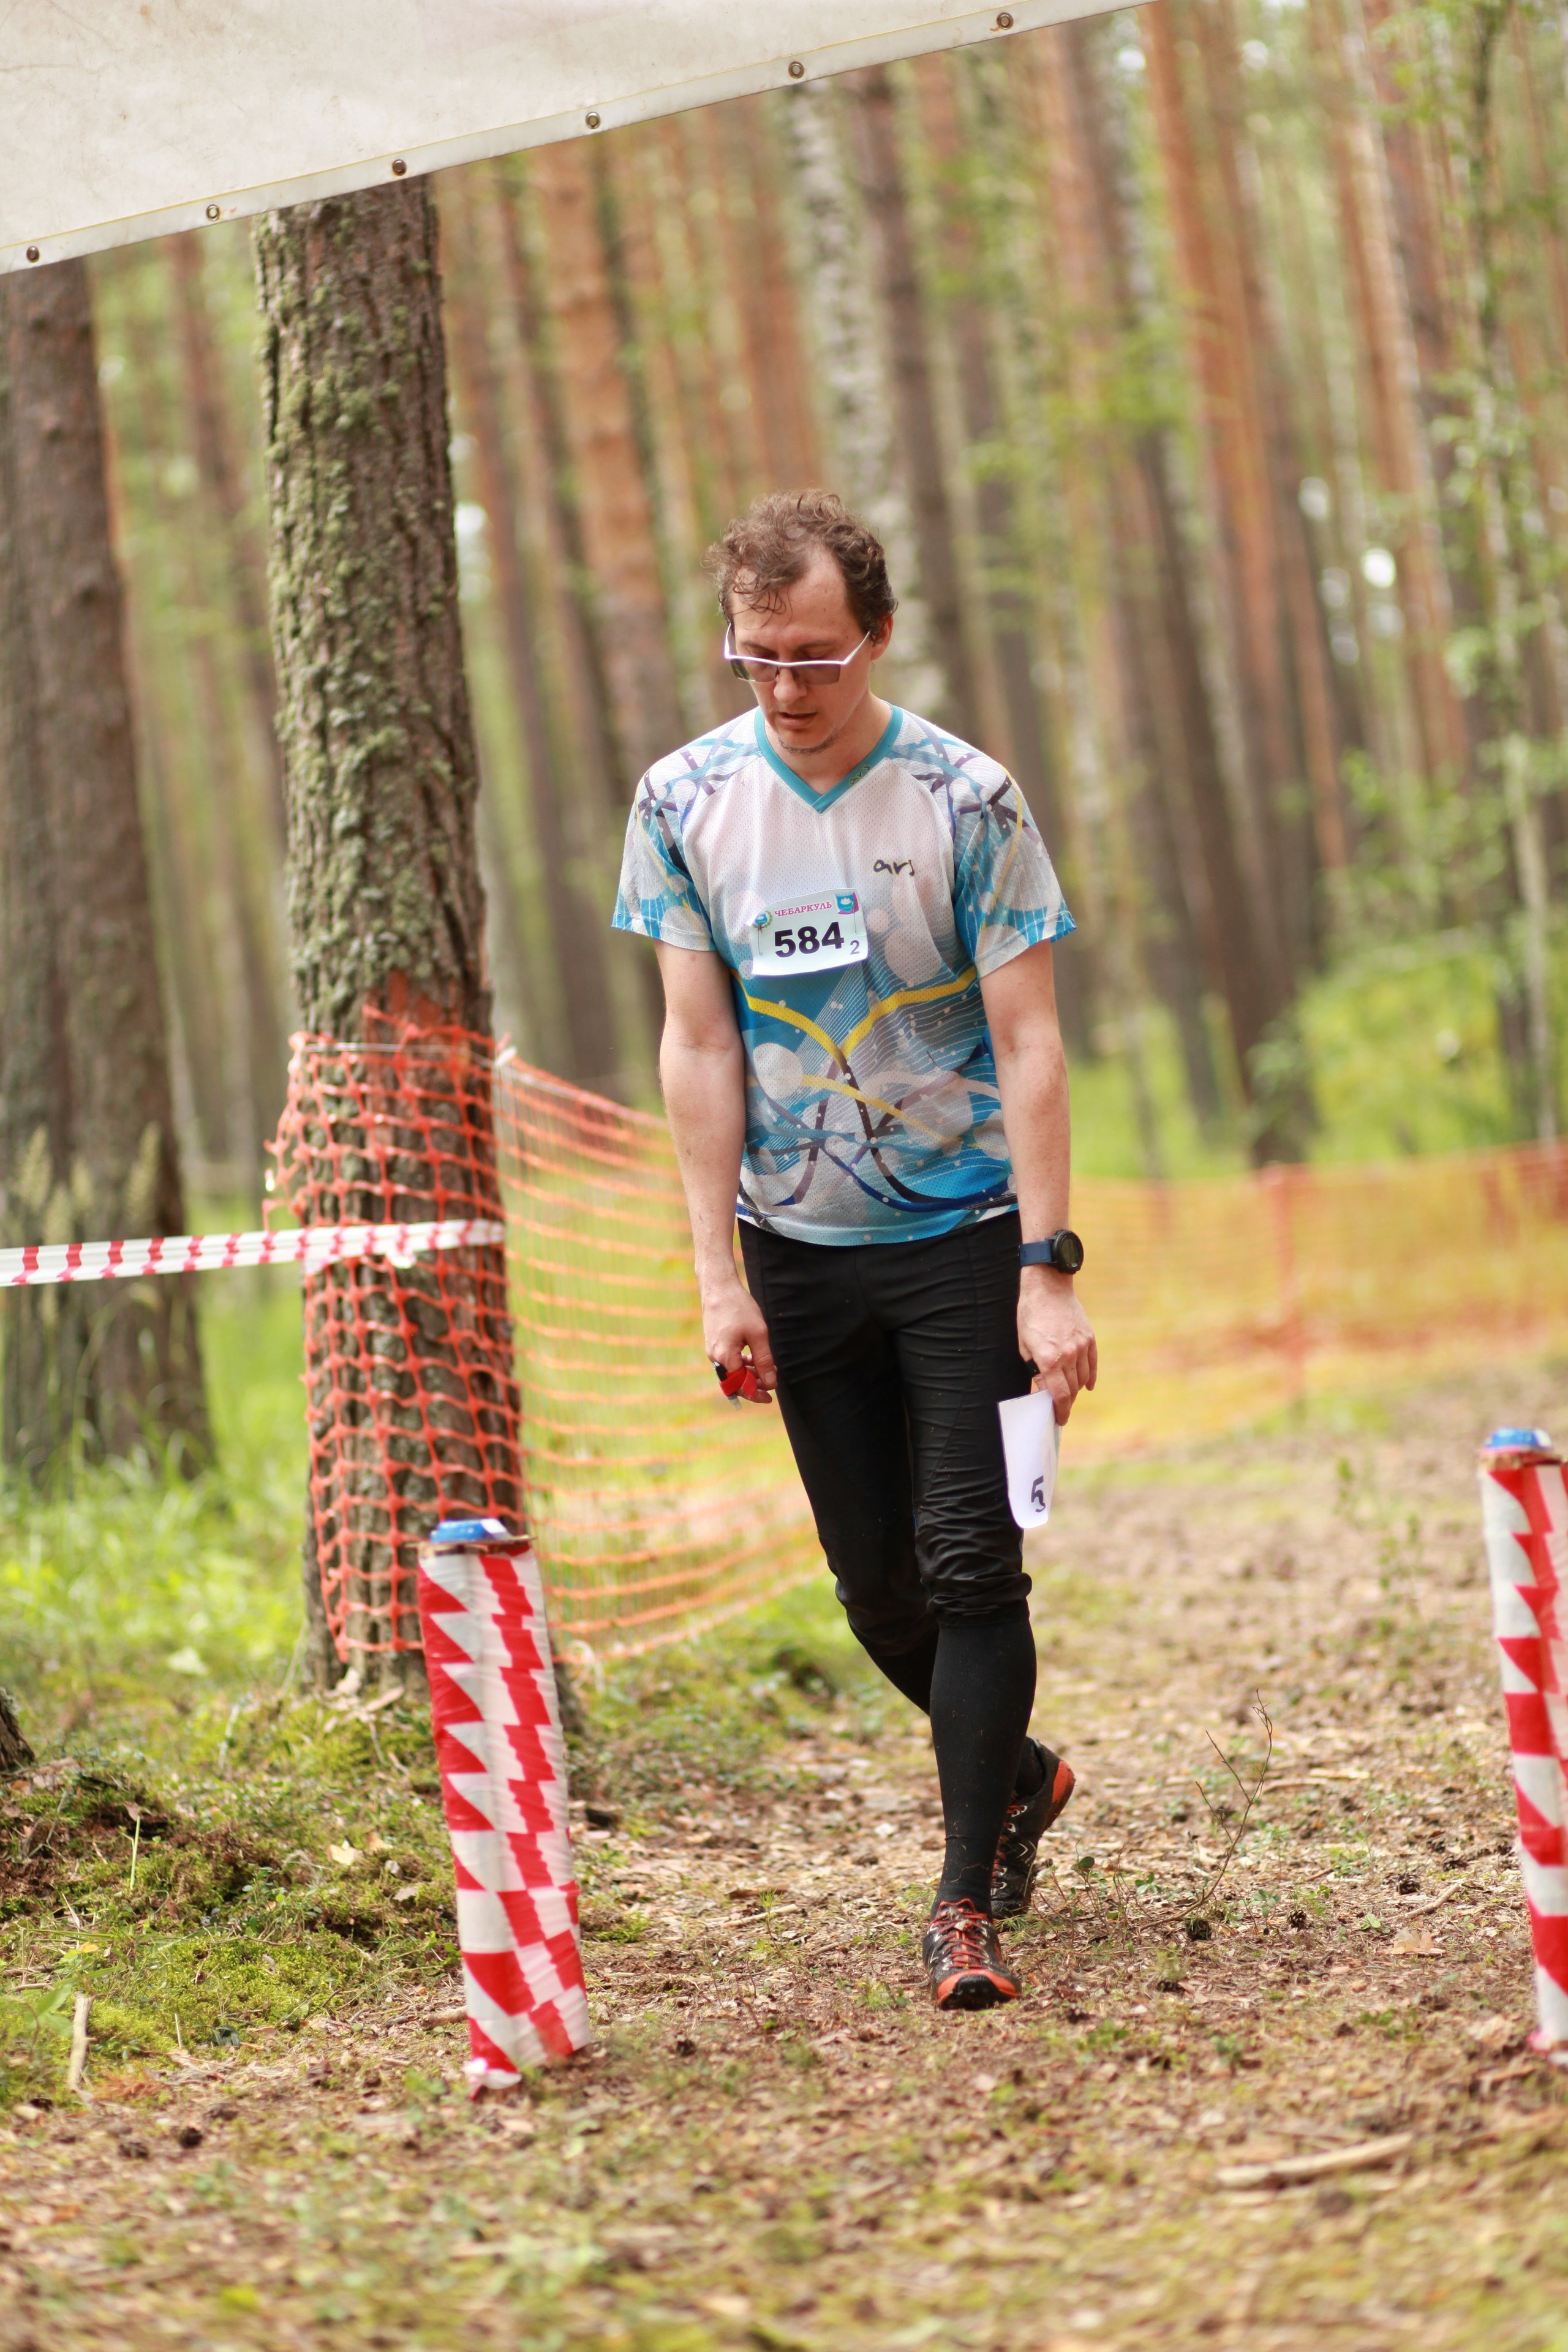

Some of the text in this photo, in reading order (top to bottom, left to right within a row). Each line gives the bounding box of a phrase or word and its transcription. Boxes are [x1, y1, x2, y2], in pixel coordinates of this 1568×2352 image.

[774, 902, 832, 917] ЧЕБАРКУЛЬ
[774, 921, 860, 958] 584 2
